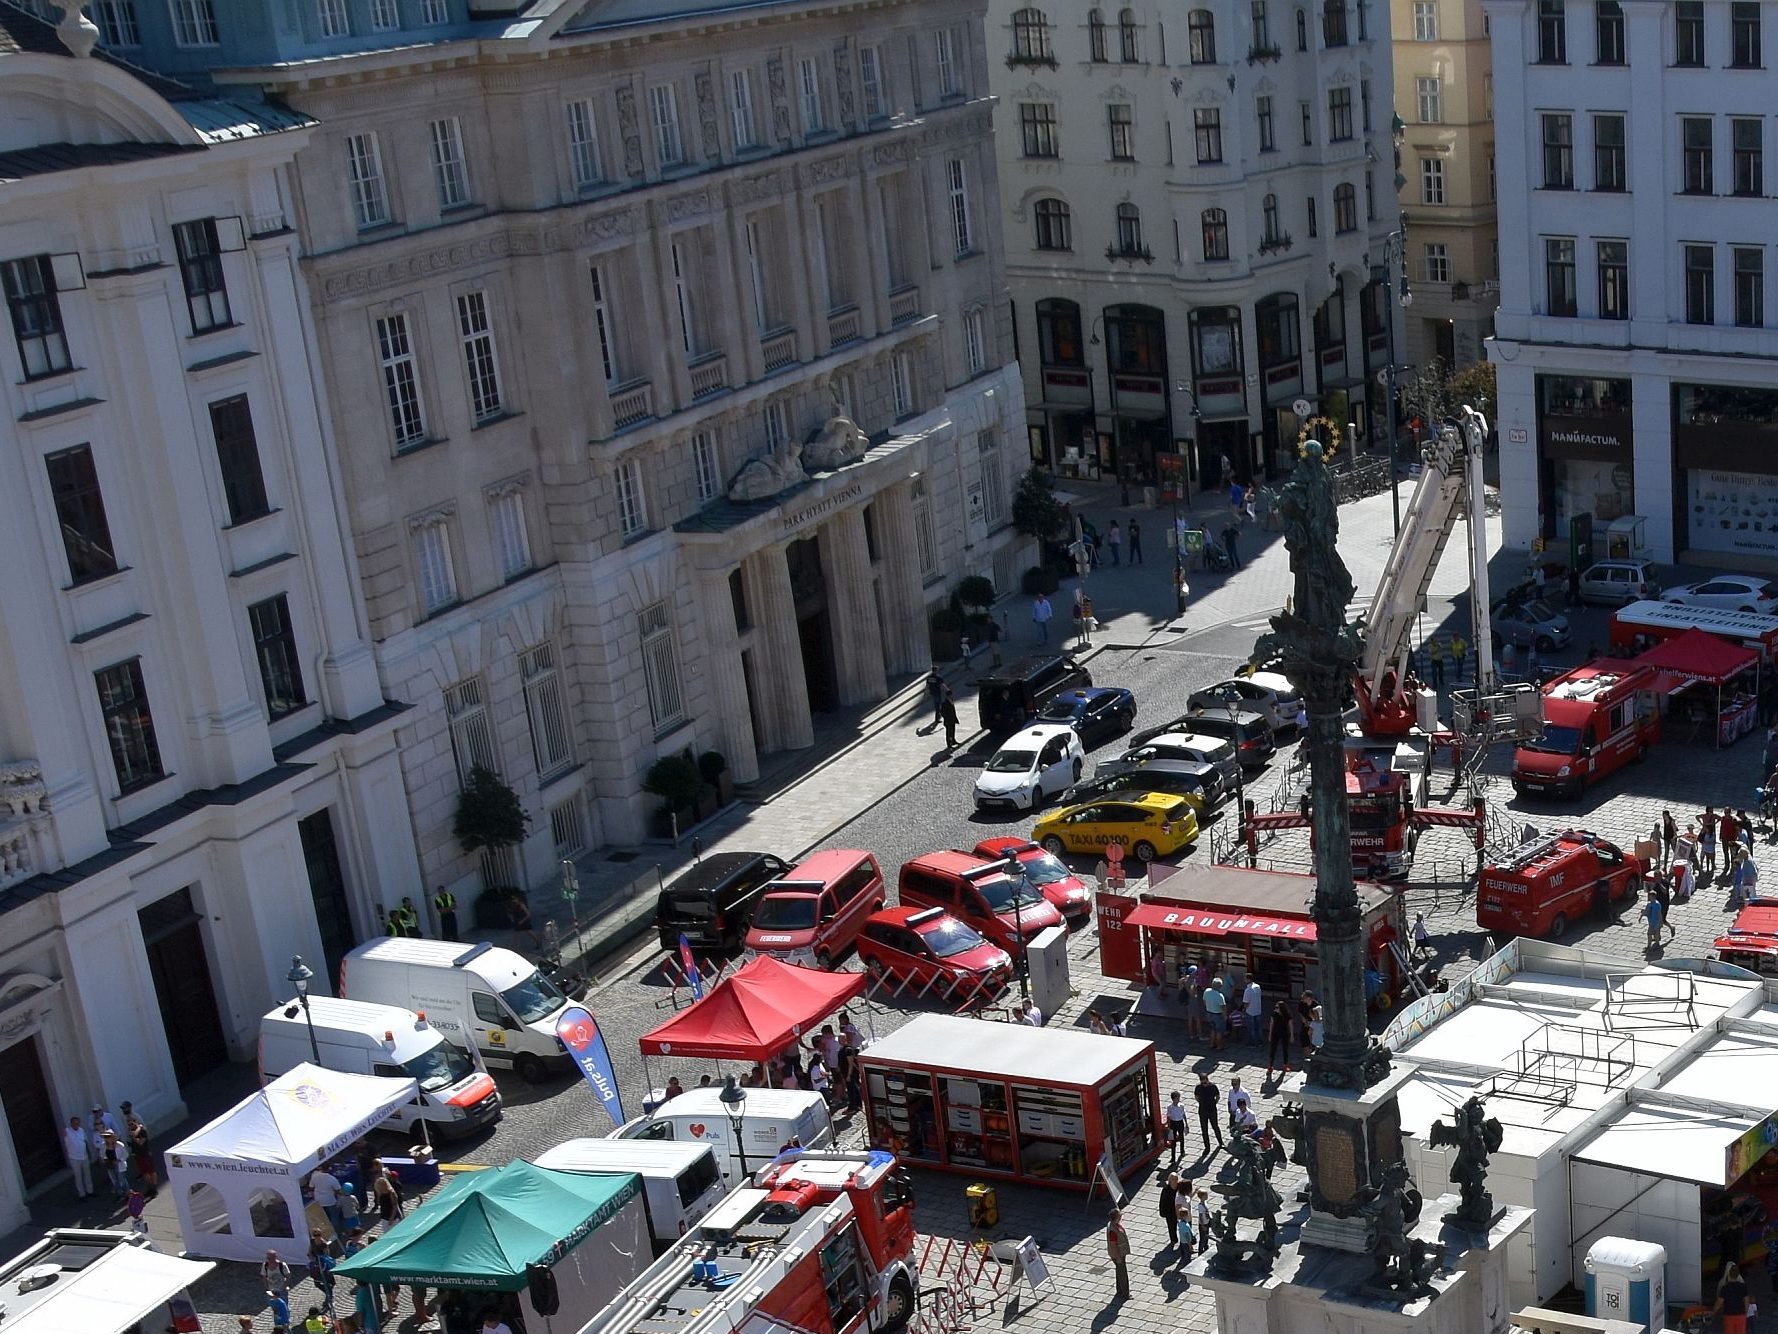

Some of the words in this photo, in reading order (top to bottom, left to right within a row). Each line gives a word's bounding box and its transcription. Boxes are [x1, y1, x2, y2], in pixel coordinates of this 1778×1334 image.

[784, 512, 806, 530] PARK
[806, 498, 832, 521] HYATT
[834, 484, 862, 508] VIENNA
[1069, 834, 1092, 845] TAXI
[1486, 879, 1528, 896] FEUERWEHR
[1549, 872, 1565, 888] IMF
[1106, 920, 1122, 931] 122
[188, 1161, 290, 1176] www.wien.leuchtet.at
[565, 1204, 611, 1248] MARKTAMT
[612, 1184, 635, 1210] WIEN
[390, 1273, 499, 1287] www.marktamt.wien.at
